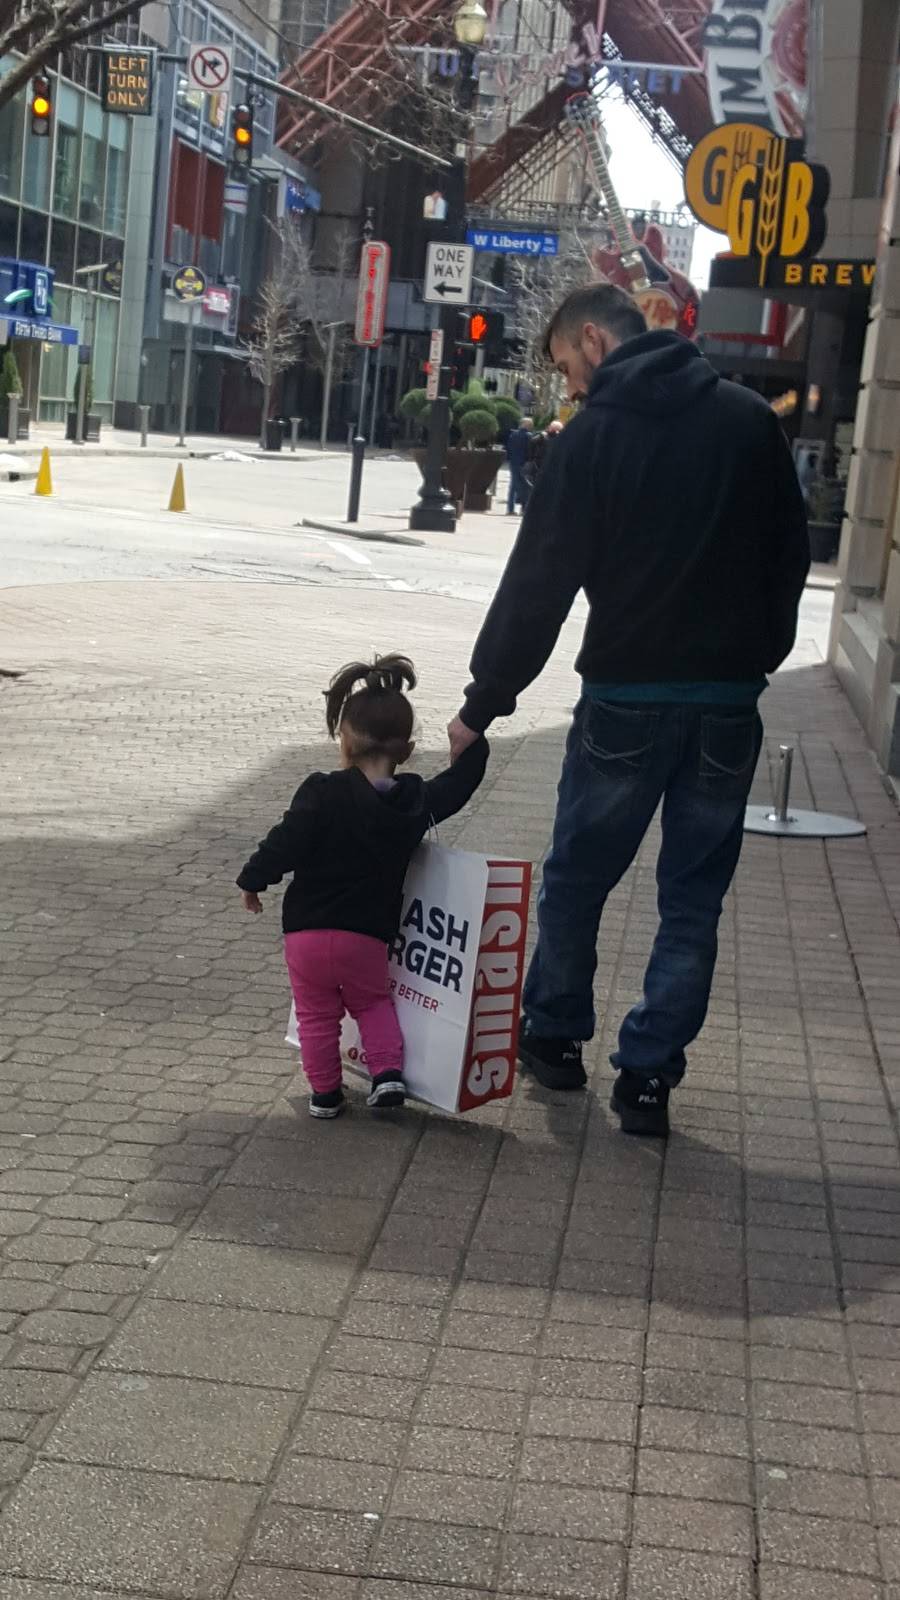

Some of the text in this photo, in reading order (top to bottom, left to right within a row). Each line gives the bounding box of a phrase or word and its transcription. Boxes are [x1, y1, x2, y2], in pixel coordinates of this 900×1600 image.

[108, 56, 147, 72] LEFT
[107, 73, 147, 89] TURN
[107, 90, 147, 107] ONLY
[473, 234, 488, 246] W
[492, 235, 541, 252] Liberty
[435, 248, 465, 263] ONE
[433, 264, 465, 279] WAY
[402, 897, 469, 953] ASH
[398, 983, 439, 1012] BETTER
[638, 1094, 657, 1103] FILA
